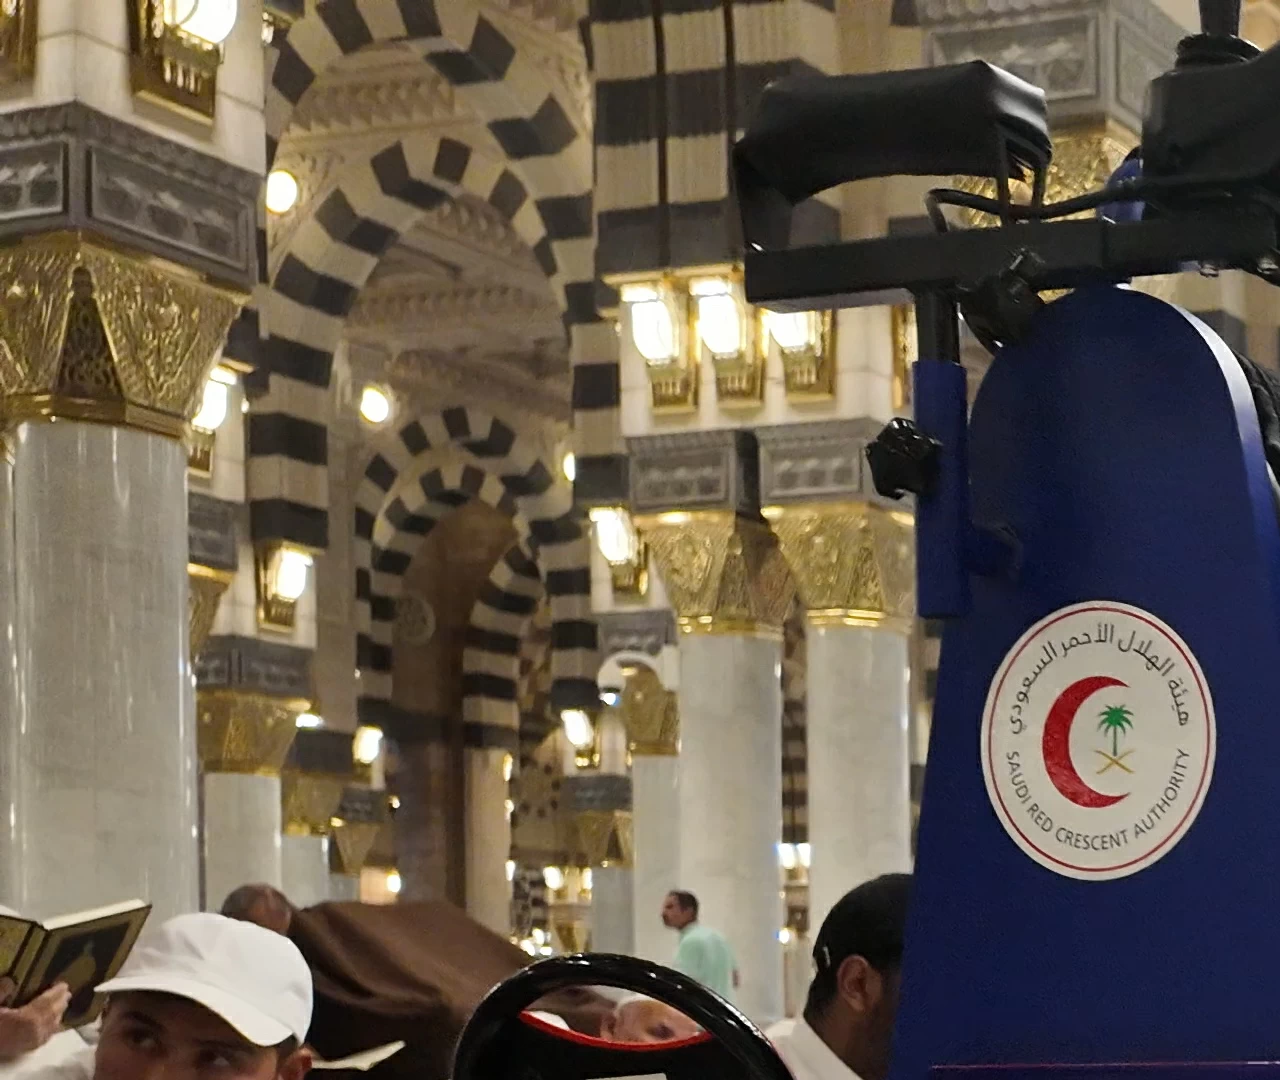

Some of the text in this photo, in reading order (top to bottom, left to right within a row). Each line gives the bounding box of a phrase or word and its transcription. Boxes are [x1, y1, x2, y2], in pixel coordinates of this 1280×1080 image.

[1010, 622, 1189, 735] هيئة الهلال الأحمر السعودي
[1006, 749, 1190, 850] SAUDI RED CRESCENT AUTHORITY
